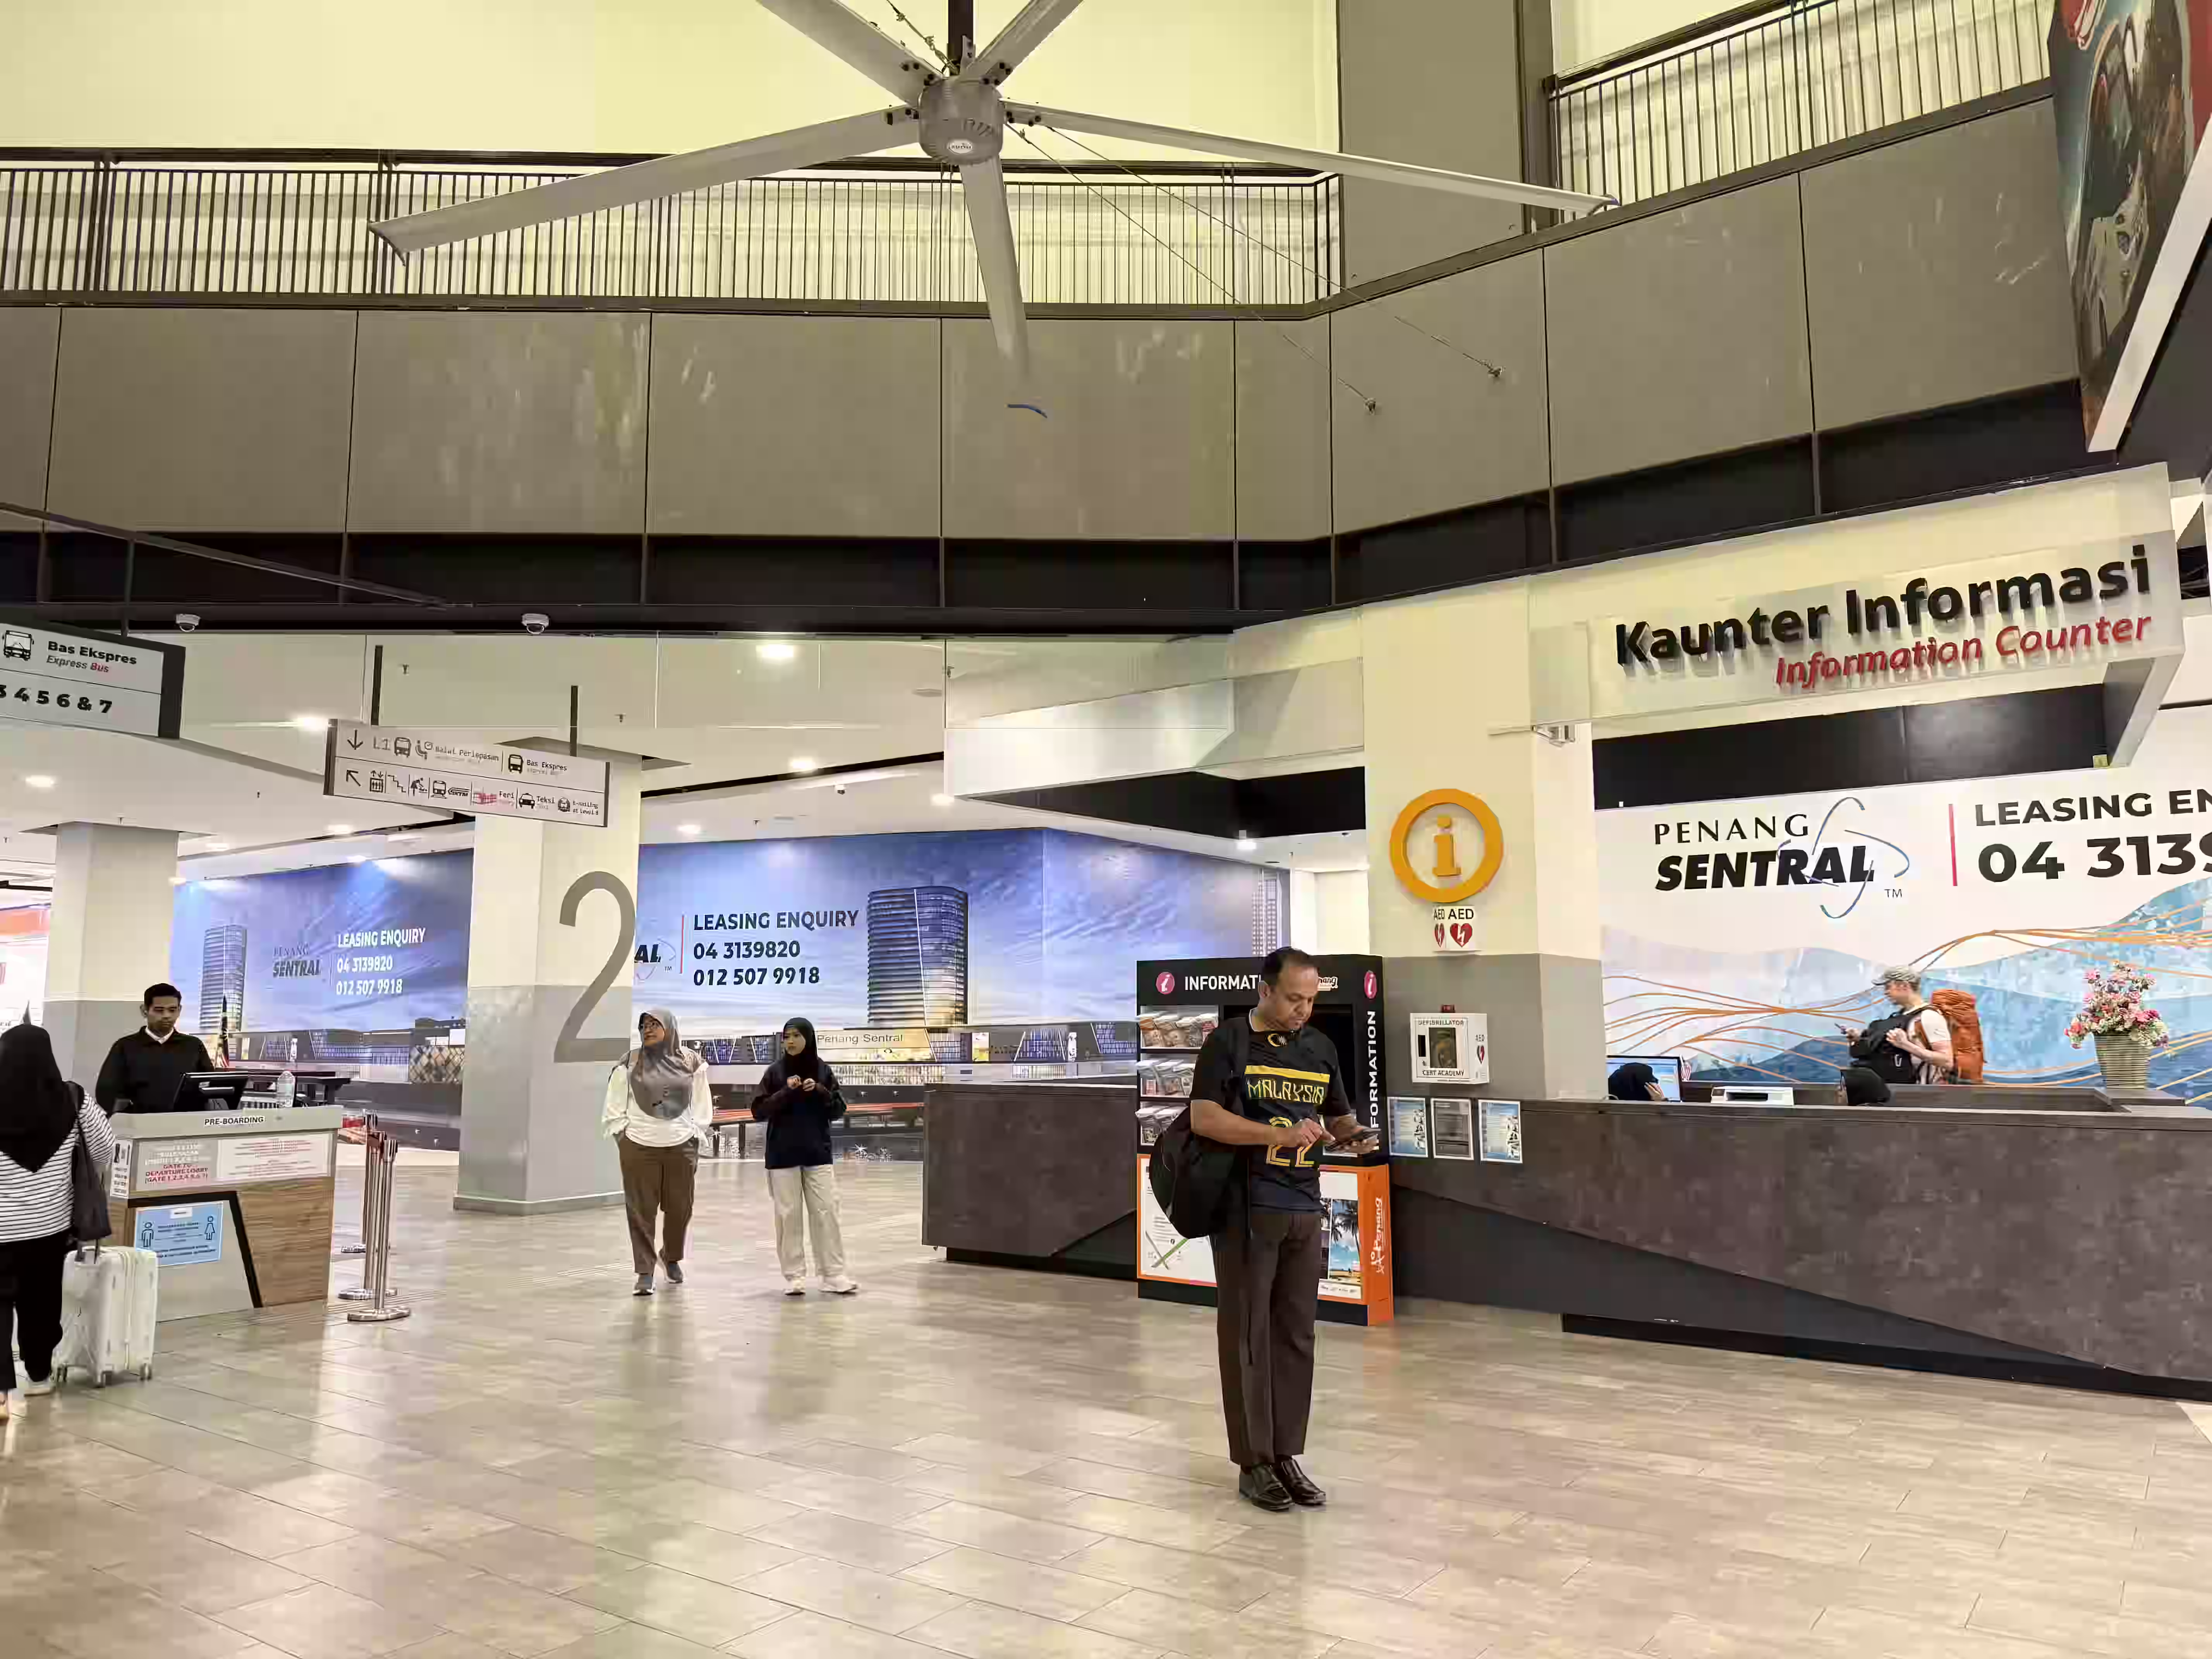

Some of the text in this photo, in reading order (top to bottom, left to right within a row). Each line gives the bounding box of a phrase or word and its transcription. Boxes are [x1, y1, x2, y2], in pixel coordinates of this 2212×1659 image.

[1616, 544, 2150, 665] Kaunter Informasi
[48, 641, 137, 664] Bas Ekspres
[1776, 616, 2152, 688] Information Counter
[46, 655, 109, 672] Express Bus
[14, 688, 29, 702] 4
[36, 690, 50, 704] 5
[57, 694, 70, 708] 6
[77, 697, 92, 711] &
[100, 699, 112, 713] 7
[542, 762, 567, 771] Ekspres
[1975, 793, 2152, 826] LEASING
[1654, 814, 1808, 845] PENANG
[1655, 845, 1874, 891] SENTRAL
[1978, 841, 2065, 883] 04
[1884, 889, 1903, 898] TM
[694, 910, 859, 931] LEASING ENQUIRY
[1448, 908, 1474, 919] AED
[337, 927, 426, 948] LEASING ENQUIRY
[694, 940, 800, 959] 04 3139820
[352, 956, 393, 972] 3139820
[554, 871, 635, 1063] 2
[336, 979, 403, 995] 012 507 9918
[694, 967, 819, 986] 012 507 9918
[1185, 974, 1261, 991] INFORMAT
[817, 1034, 903, 1045] Penang Sentral
[1367, 1011, 1379, 1128] FORMATION
[1246, 1078, 1324, 1104] MALAYSIA
[204, 1117, 264, 1125] PRE-BOARDING
